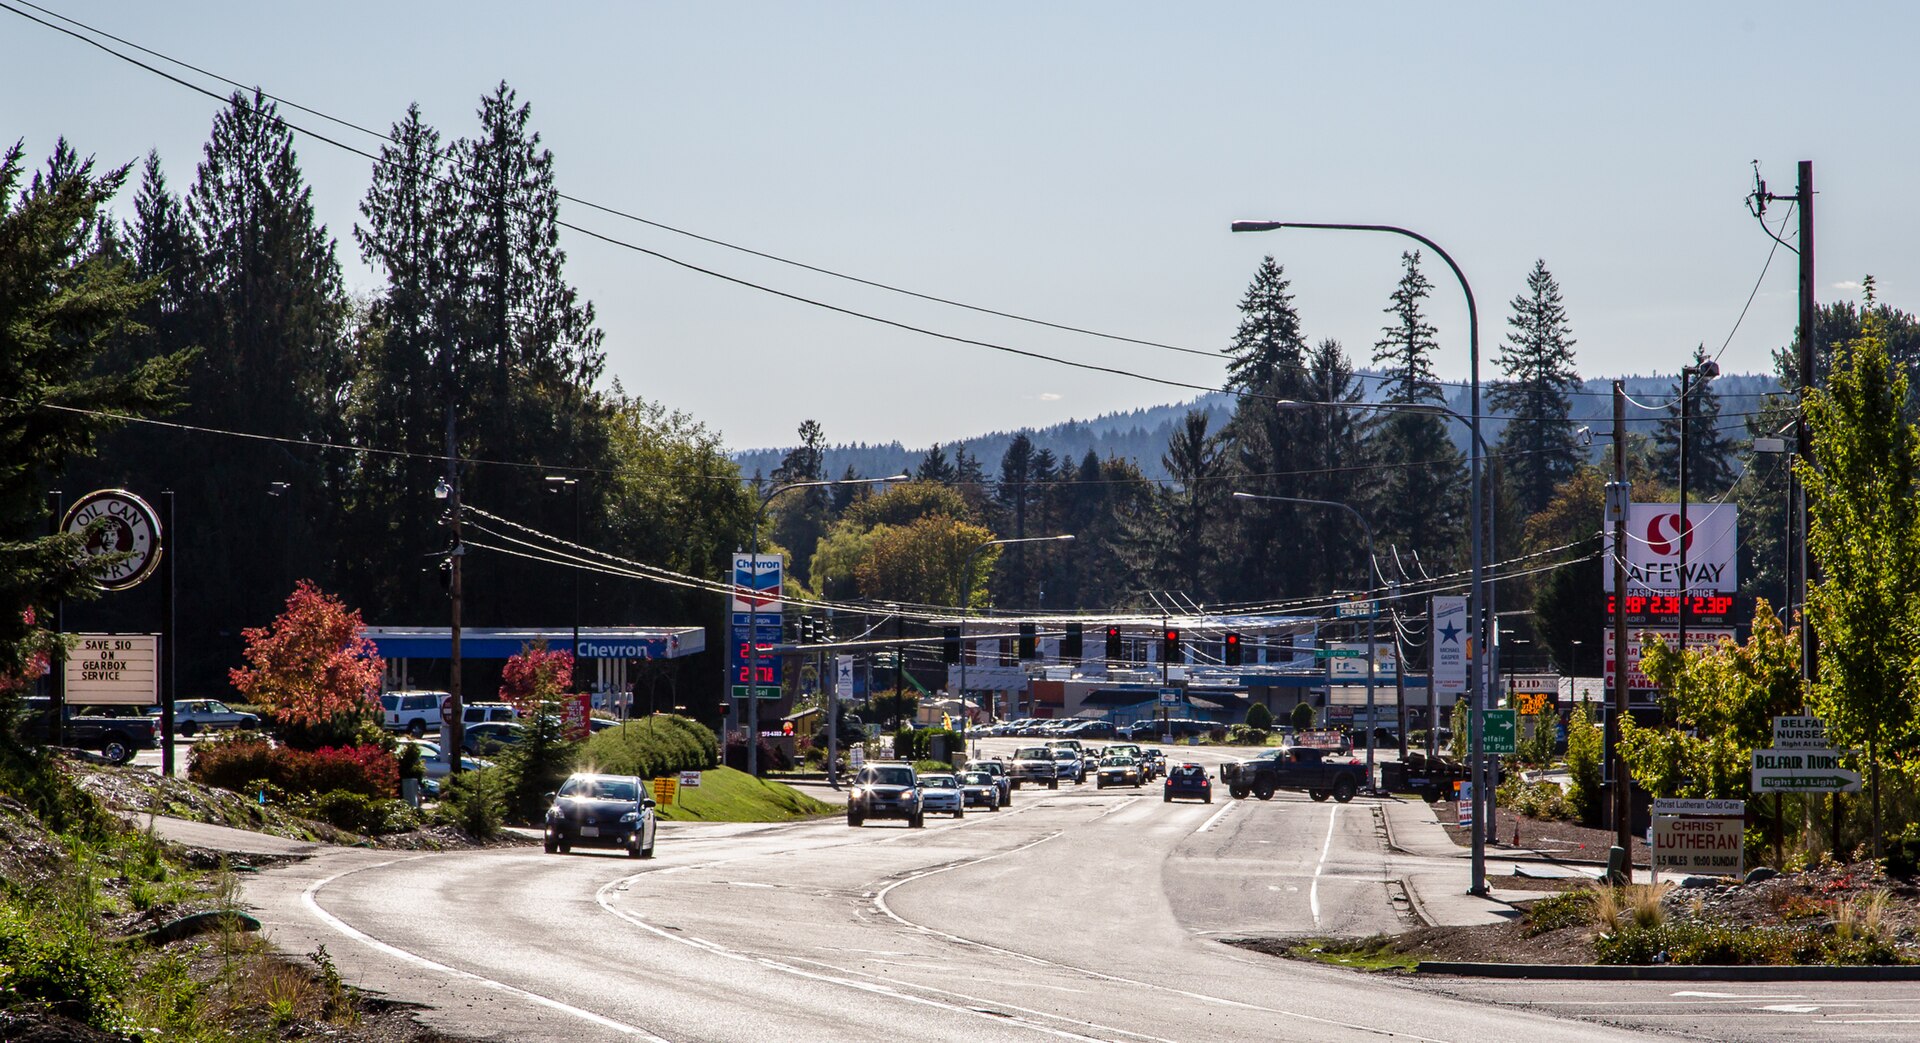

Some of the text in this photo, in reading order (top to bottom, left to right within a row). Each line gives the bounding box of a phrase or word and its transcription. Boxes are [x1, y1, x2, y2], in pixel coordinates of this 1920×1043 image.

[76, 501, 143, 527] OIL CAN
[1624, 563, 1726, 582] AFEWAY
[1626, 589, 1715, 598] CASH/DEBI PRICE
[85, 641, 109, 650] SAVE
[577, 642, 647, 658] Chevron
[101, 651, 114, 660] ON
[82, 661, 127, 671] GEARBOX
[82, 671, 120, 681] SERVICE
[1780, 719, 1826, 728] BELFAI
[1494, 743, 1514, 751] Park
[1763, 778, 1838, 787] Right At Light
[1655, 800, 1739, 809] Christ Lutheran Child Care
[1671, 821, 1724, 832] CHRIST
[1657, 833, 1738, 849] LUTHERAN
[1667, 855, 1688, 866] MILES
[1693, 855, 1711, 867] 10:00
[1711, 856, 1739, 867] SUNDAY
